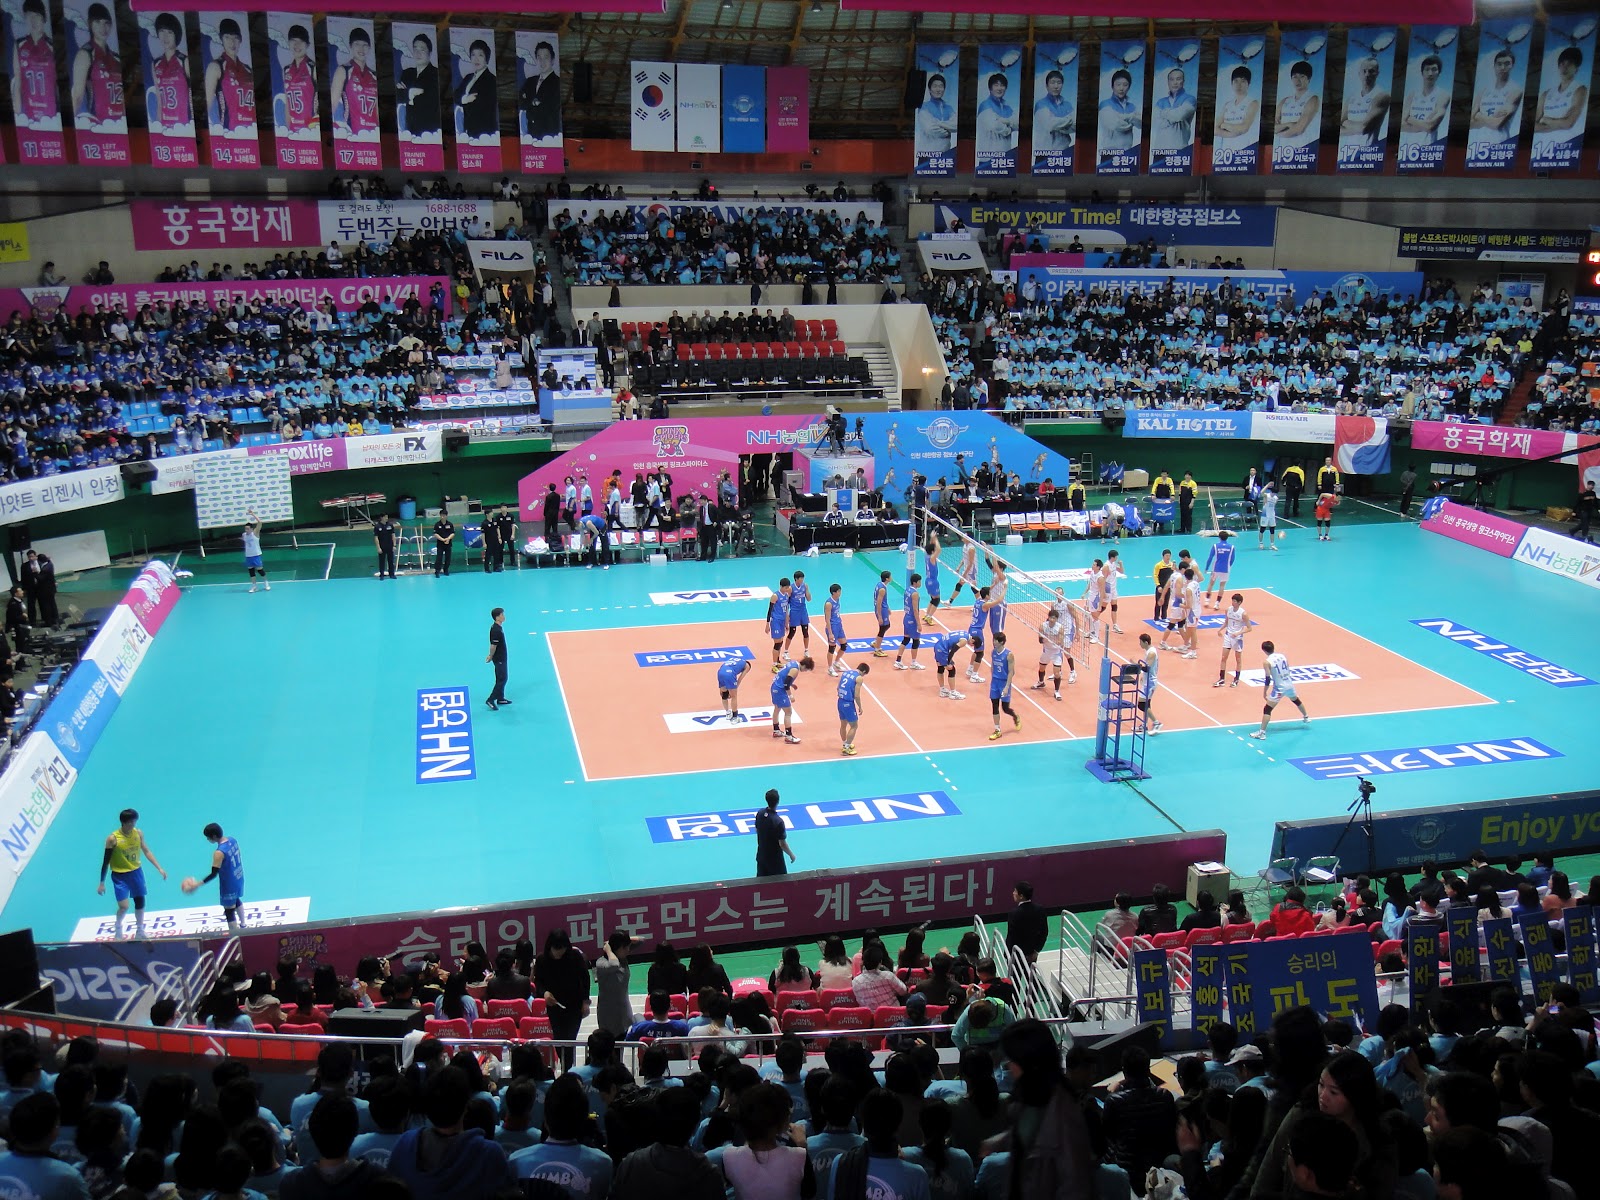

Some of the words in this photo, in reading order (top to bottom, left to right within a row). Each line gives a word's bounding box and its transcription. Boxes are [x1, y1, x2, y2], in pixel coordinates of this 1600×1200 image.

[287, 90, 303, 114] 15
[23, 141, 38, 158] 11
[83, 144, 101, 159] 12
[155, 145, 171, 162] 13
[214, 148, 232, 164] 14
[280, 148, 297, 164] 15
[339, 150, 355, 165] 17
[1214, 148, 1233, 165] 20
[1275, 146, 1295, 163] 19
[1340, 144, 1360, 162] 17
[1399, 143, 1420, 161] 16
[1468, 142, 1490, 160] 15
[1533, 140, 1555, 160] 14
[425, 203, 477, 213] 1688-1688
[971, 207, 1021, 227] Enjoy
[1024, 210, 1066, 227] your
[1070, 207, 1122, 226] Time!
[163, 204, 293, 246] 흥국화재
[1130, 208, 1242, 227] 대한항공점보스
[481, 250, 524, 262] FILA
[931, 252, 972, 262] FILA
[340, 285, 380, 305] GO!
[385, 284, 420, 302] V4!
[1045, 280, 1083, 302] 인천
[1137, 418, 1174, 430] KAL
[1176, 419, 1237, 432] HOTEL
[404, 436, 427, 452] FX
[1443, 426, 1532, 456] 흥국화재
[42, 483, 84, 506] 리젠시
[90, 474, 119, 497] 인천
[674, 590, 752, 600] FILA
[1273, 660, 1288, 674] 14
[841, 678, 848, 688] 2
[420, 691, 473, 779] NH농협
[1302, 739, 1551, 778] NH카드
[1480, 812, 1564, 848] Enjoy
[230, 850, 242, 868] 17
[567, 891, 788, 948] 퍼포먼스는
[814, 867, 994, 922] 계속된다!
[287, 935, 317, 946] PINK
[1287, 950, 1337, 975] 승리의
[1269, 978, 1360, 1020] 파도
